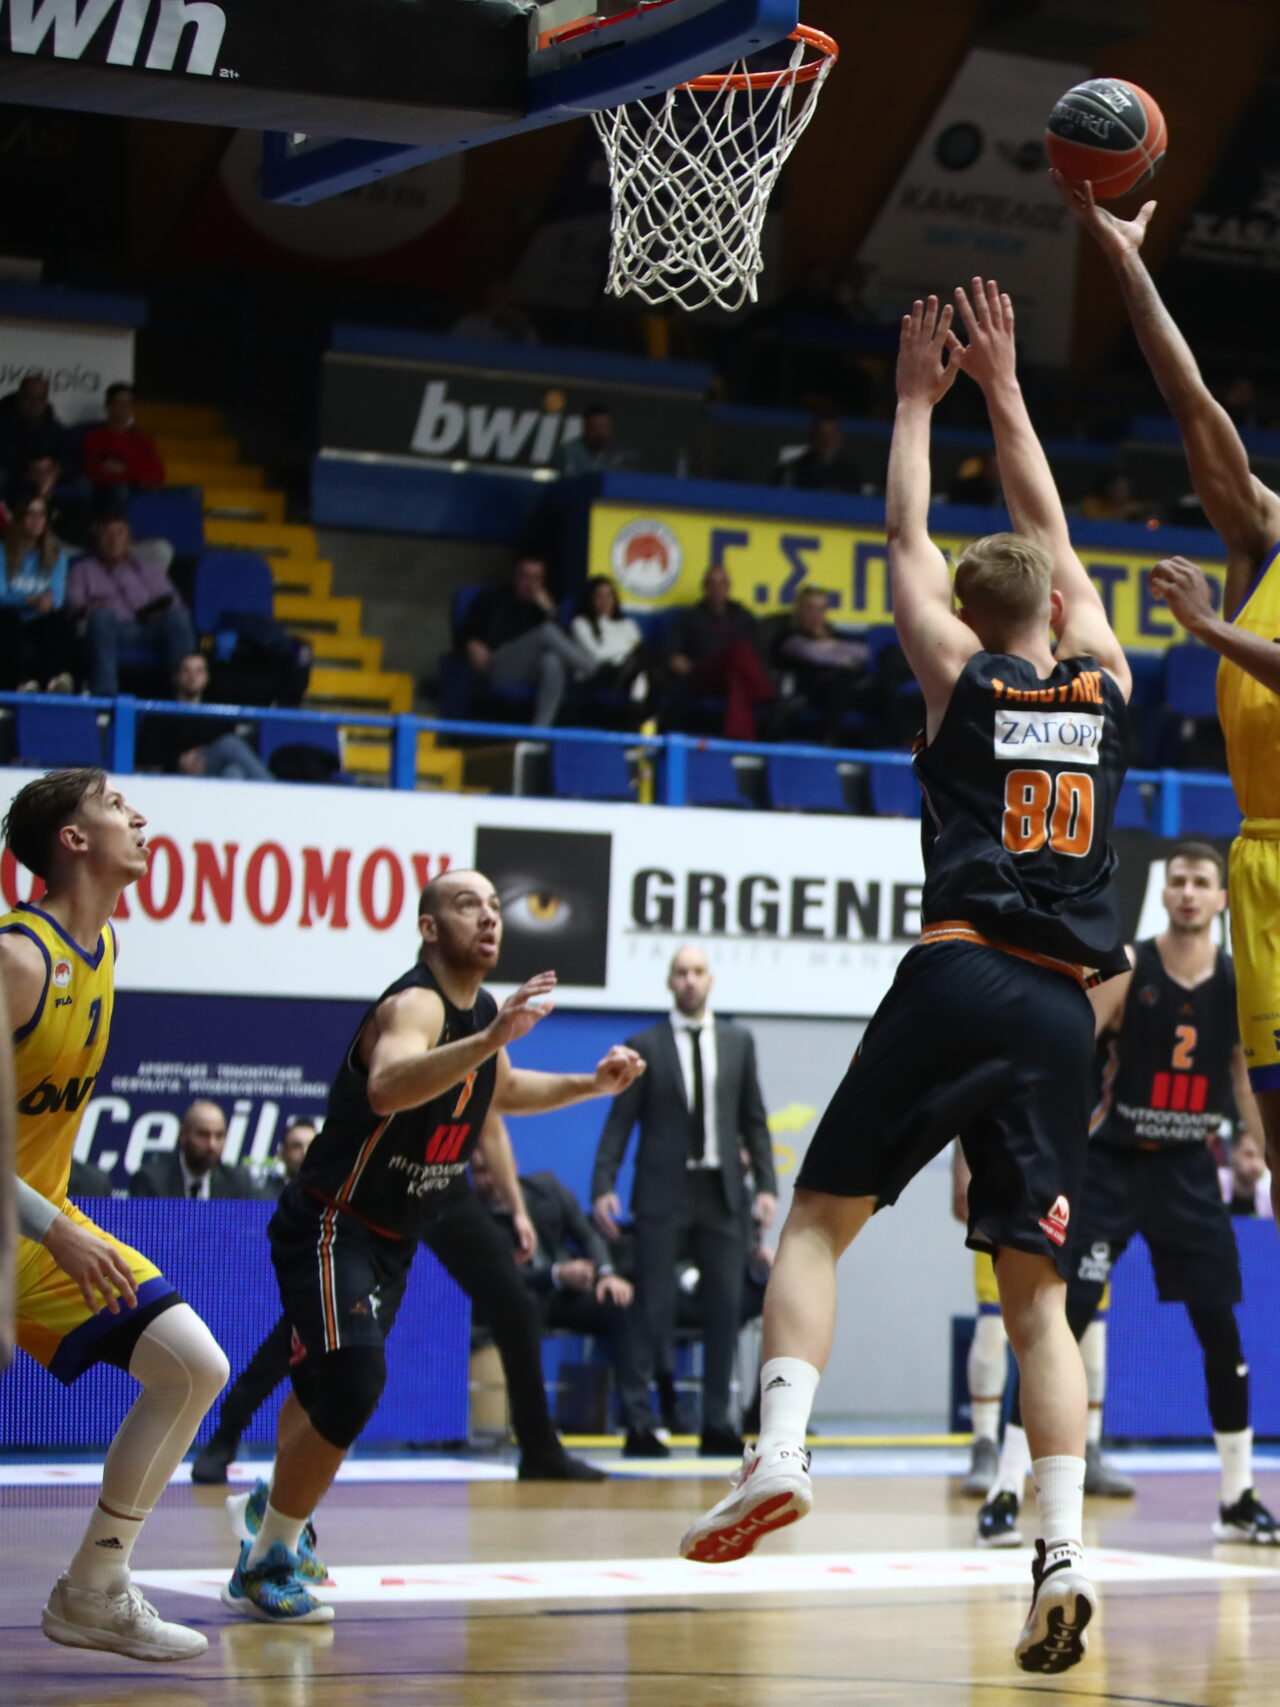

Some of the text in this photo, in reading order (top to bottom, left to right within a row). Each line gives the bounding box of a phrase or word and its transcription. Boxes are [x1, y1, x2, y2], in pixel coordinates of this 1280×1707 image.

[0, 0, 227, 76] win
[1002, 769, 1095, 858] 80
[1172, 1024, 1197, 1069] 2
